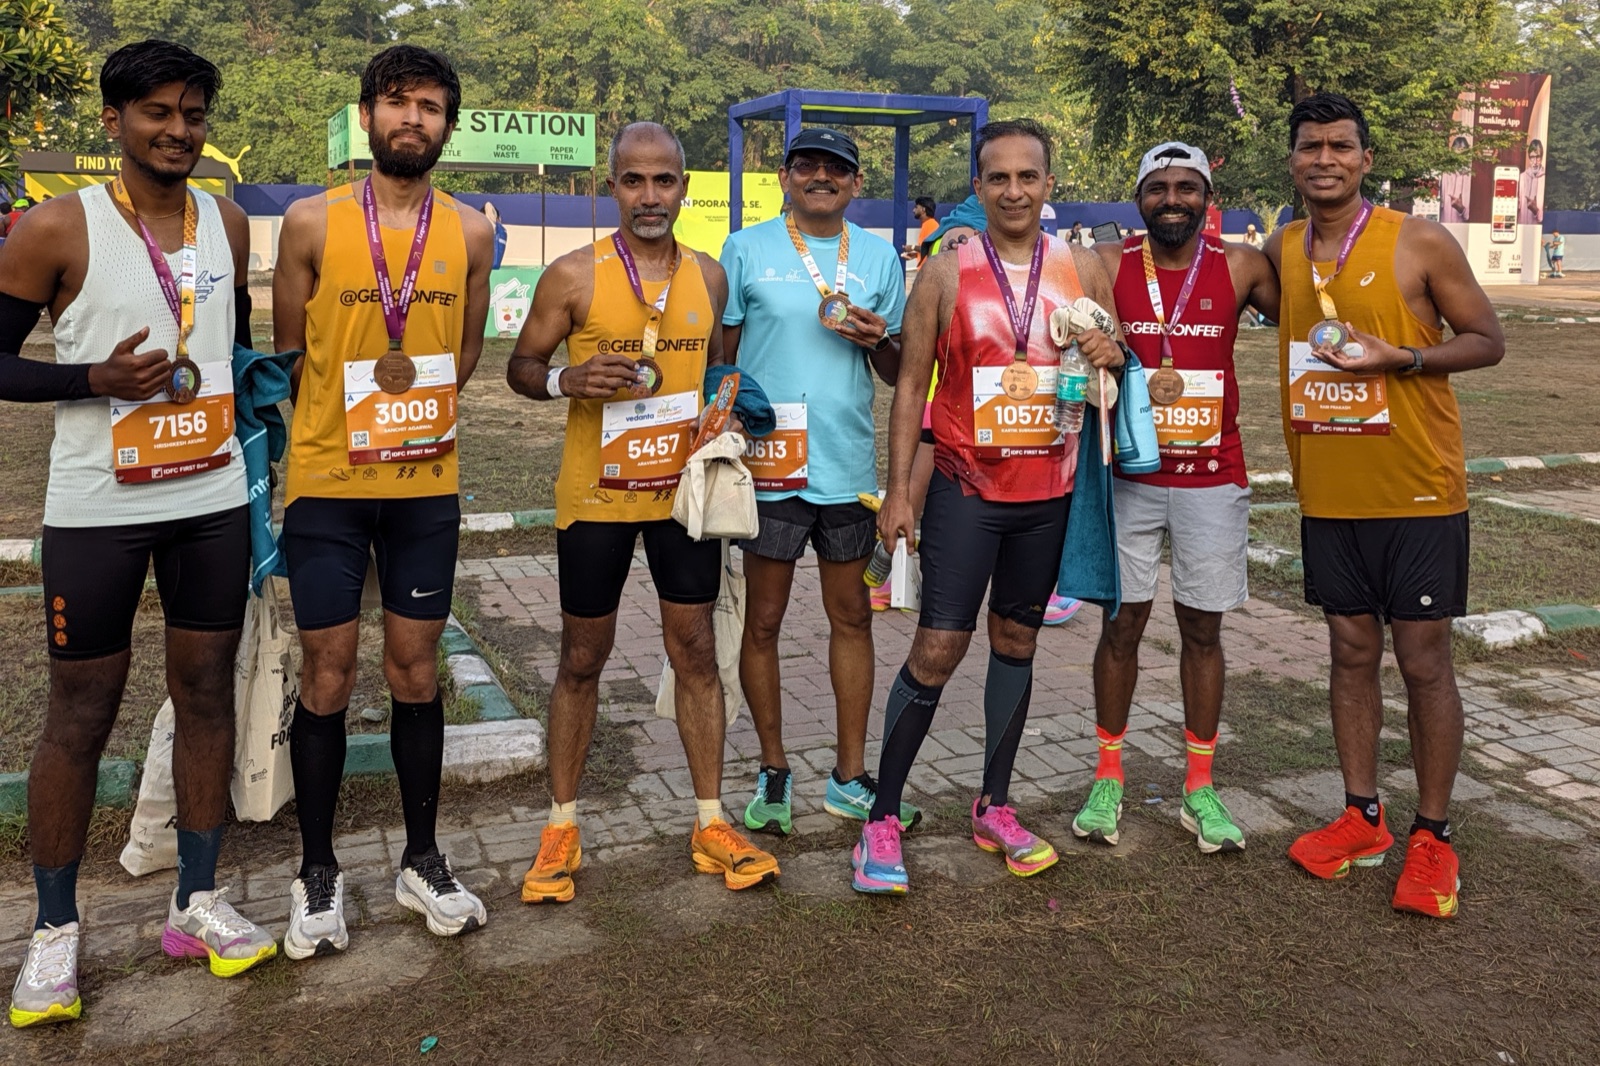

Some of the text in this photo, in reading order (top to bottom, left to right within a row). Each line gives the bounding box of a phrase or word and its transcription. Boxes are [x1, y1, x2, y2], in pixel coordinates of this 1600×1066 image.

[1479, 106, 1501, 115] Mobile
[470, 111, 585, 136] STATION
[1479, 115, 1520, 127] Banking App
[493, 151, 520, 159] WASTE
[550, 145, 574, 153] PAPER
[76, 156, 105, 170] FIND
[550, 153, 574, 161] TETRA
[749, 200, 762, 209] SE.
[1304, 381, 1369, 403] 47053
[112, 408, 120, 416] A
[374, 398, 439, 425] 3008
[625, 413, 654, 422] vedanta
[994, 405, 1055, 425] 10573
[1152, 406, 1211, 426] 51993
[148, 411, 208, 440] 7156
[153, 440, 187, 449] HRISHIKESH
[628, 433, 680, 459] 5457
[391, 450, 406, 458] IDFC
[163, 462, 209, 475] IDFC FIRST Bank
